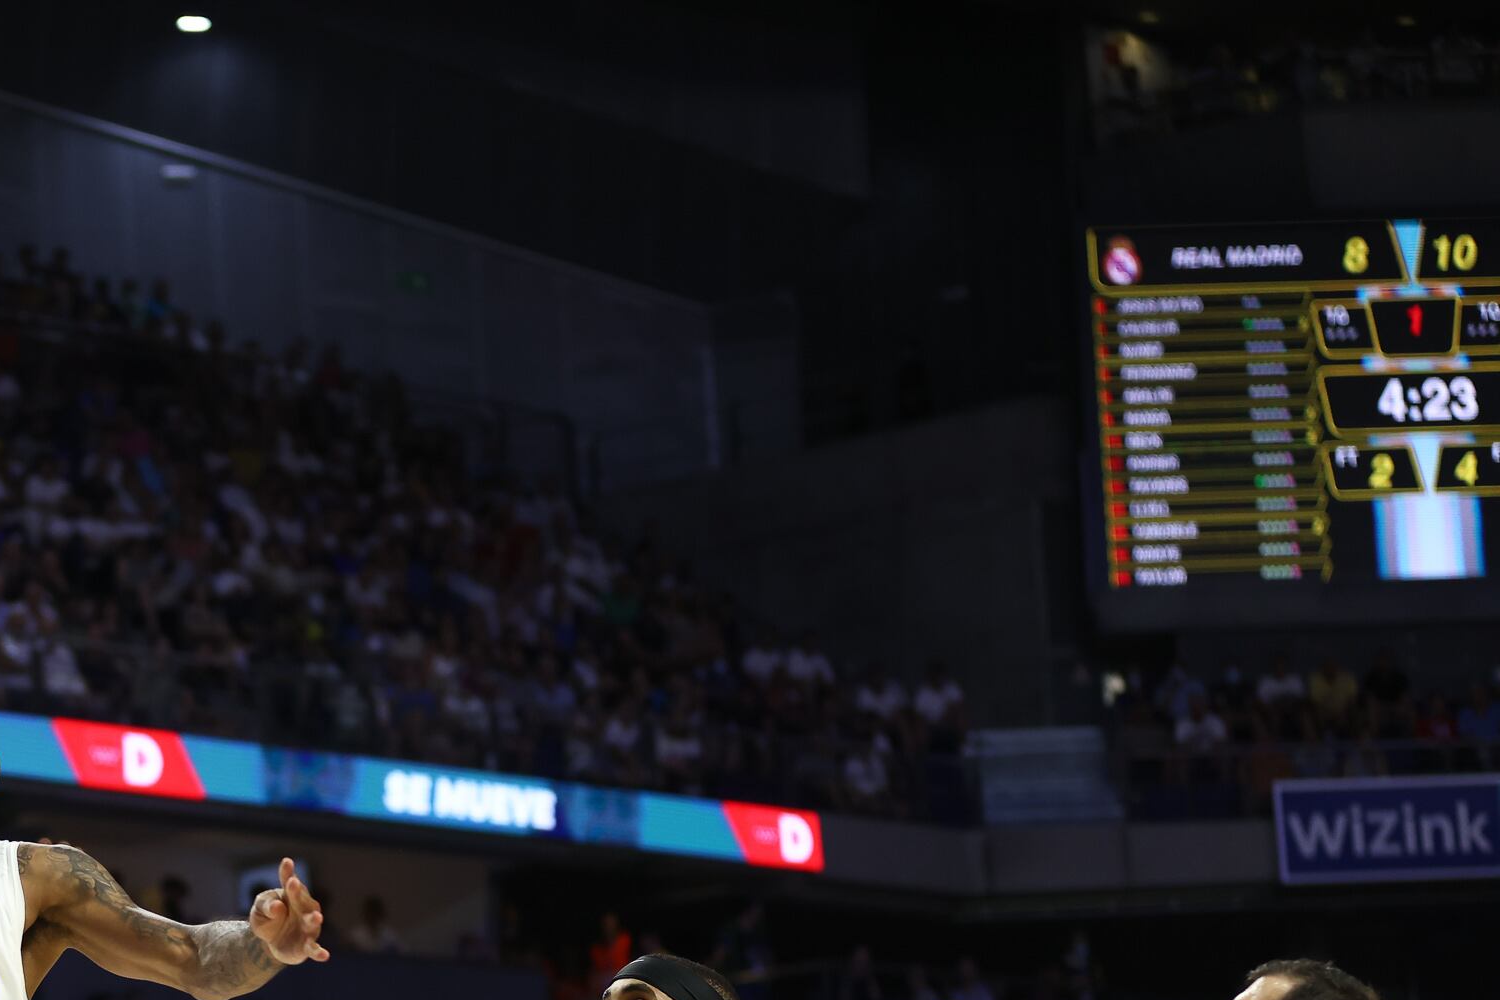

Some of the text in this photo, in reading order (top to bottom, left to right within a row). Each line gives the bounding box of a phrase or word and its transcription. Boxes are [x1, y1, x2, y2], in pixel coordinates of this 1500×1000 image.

[1343, 236, 1369, 273] 8
[1434, 234, 1478, 271] 10
[1407, 303, 1423, 337] 1
[1378, 375, 1479, 423] 4:23
[1368, 453, 1395, 488] 2
[1454, 450, 1479, 487] 4
[382, 769, 557, 831] SE MUEVE
